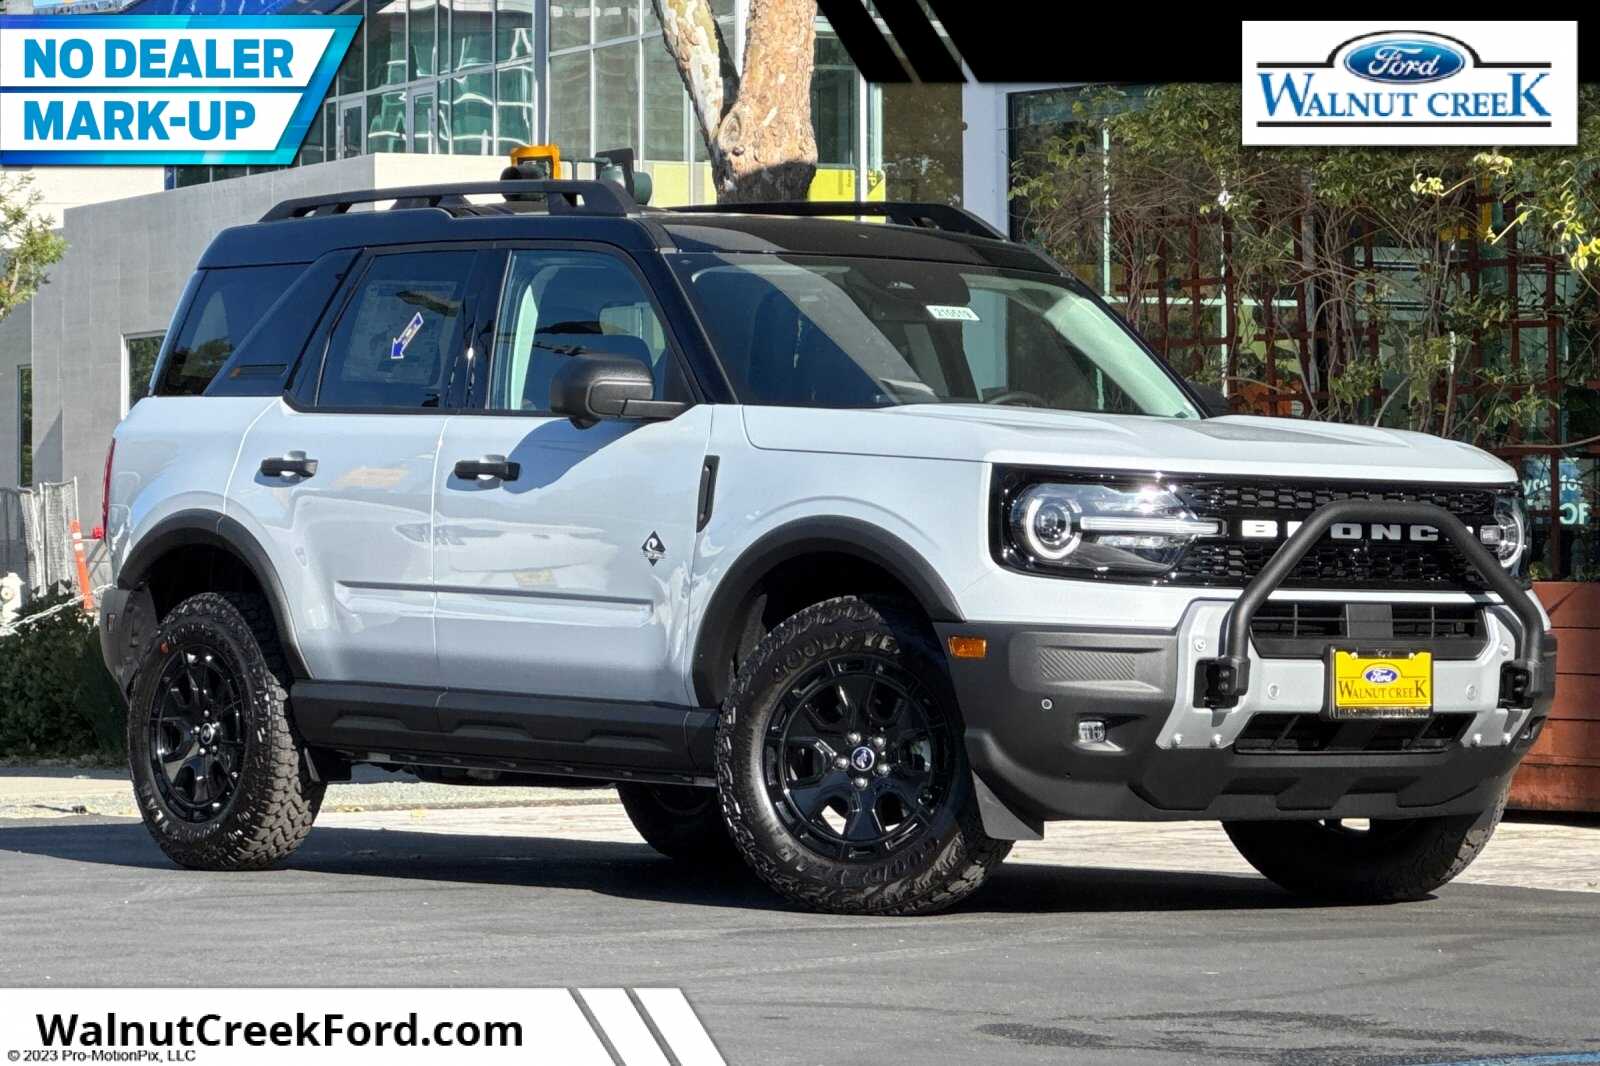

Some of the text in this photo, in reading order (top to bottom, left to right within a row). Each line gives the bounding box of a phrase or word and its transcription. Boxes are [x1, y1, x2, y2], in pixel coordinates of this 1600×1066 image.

[1370, 669, 1393, 682] Ford
[1338, 679, 1427, 699] WALNUT CREEK
